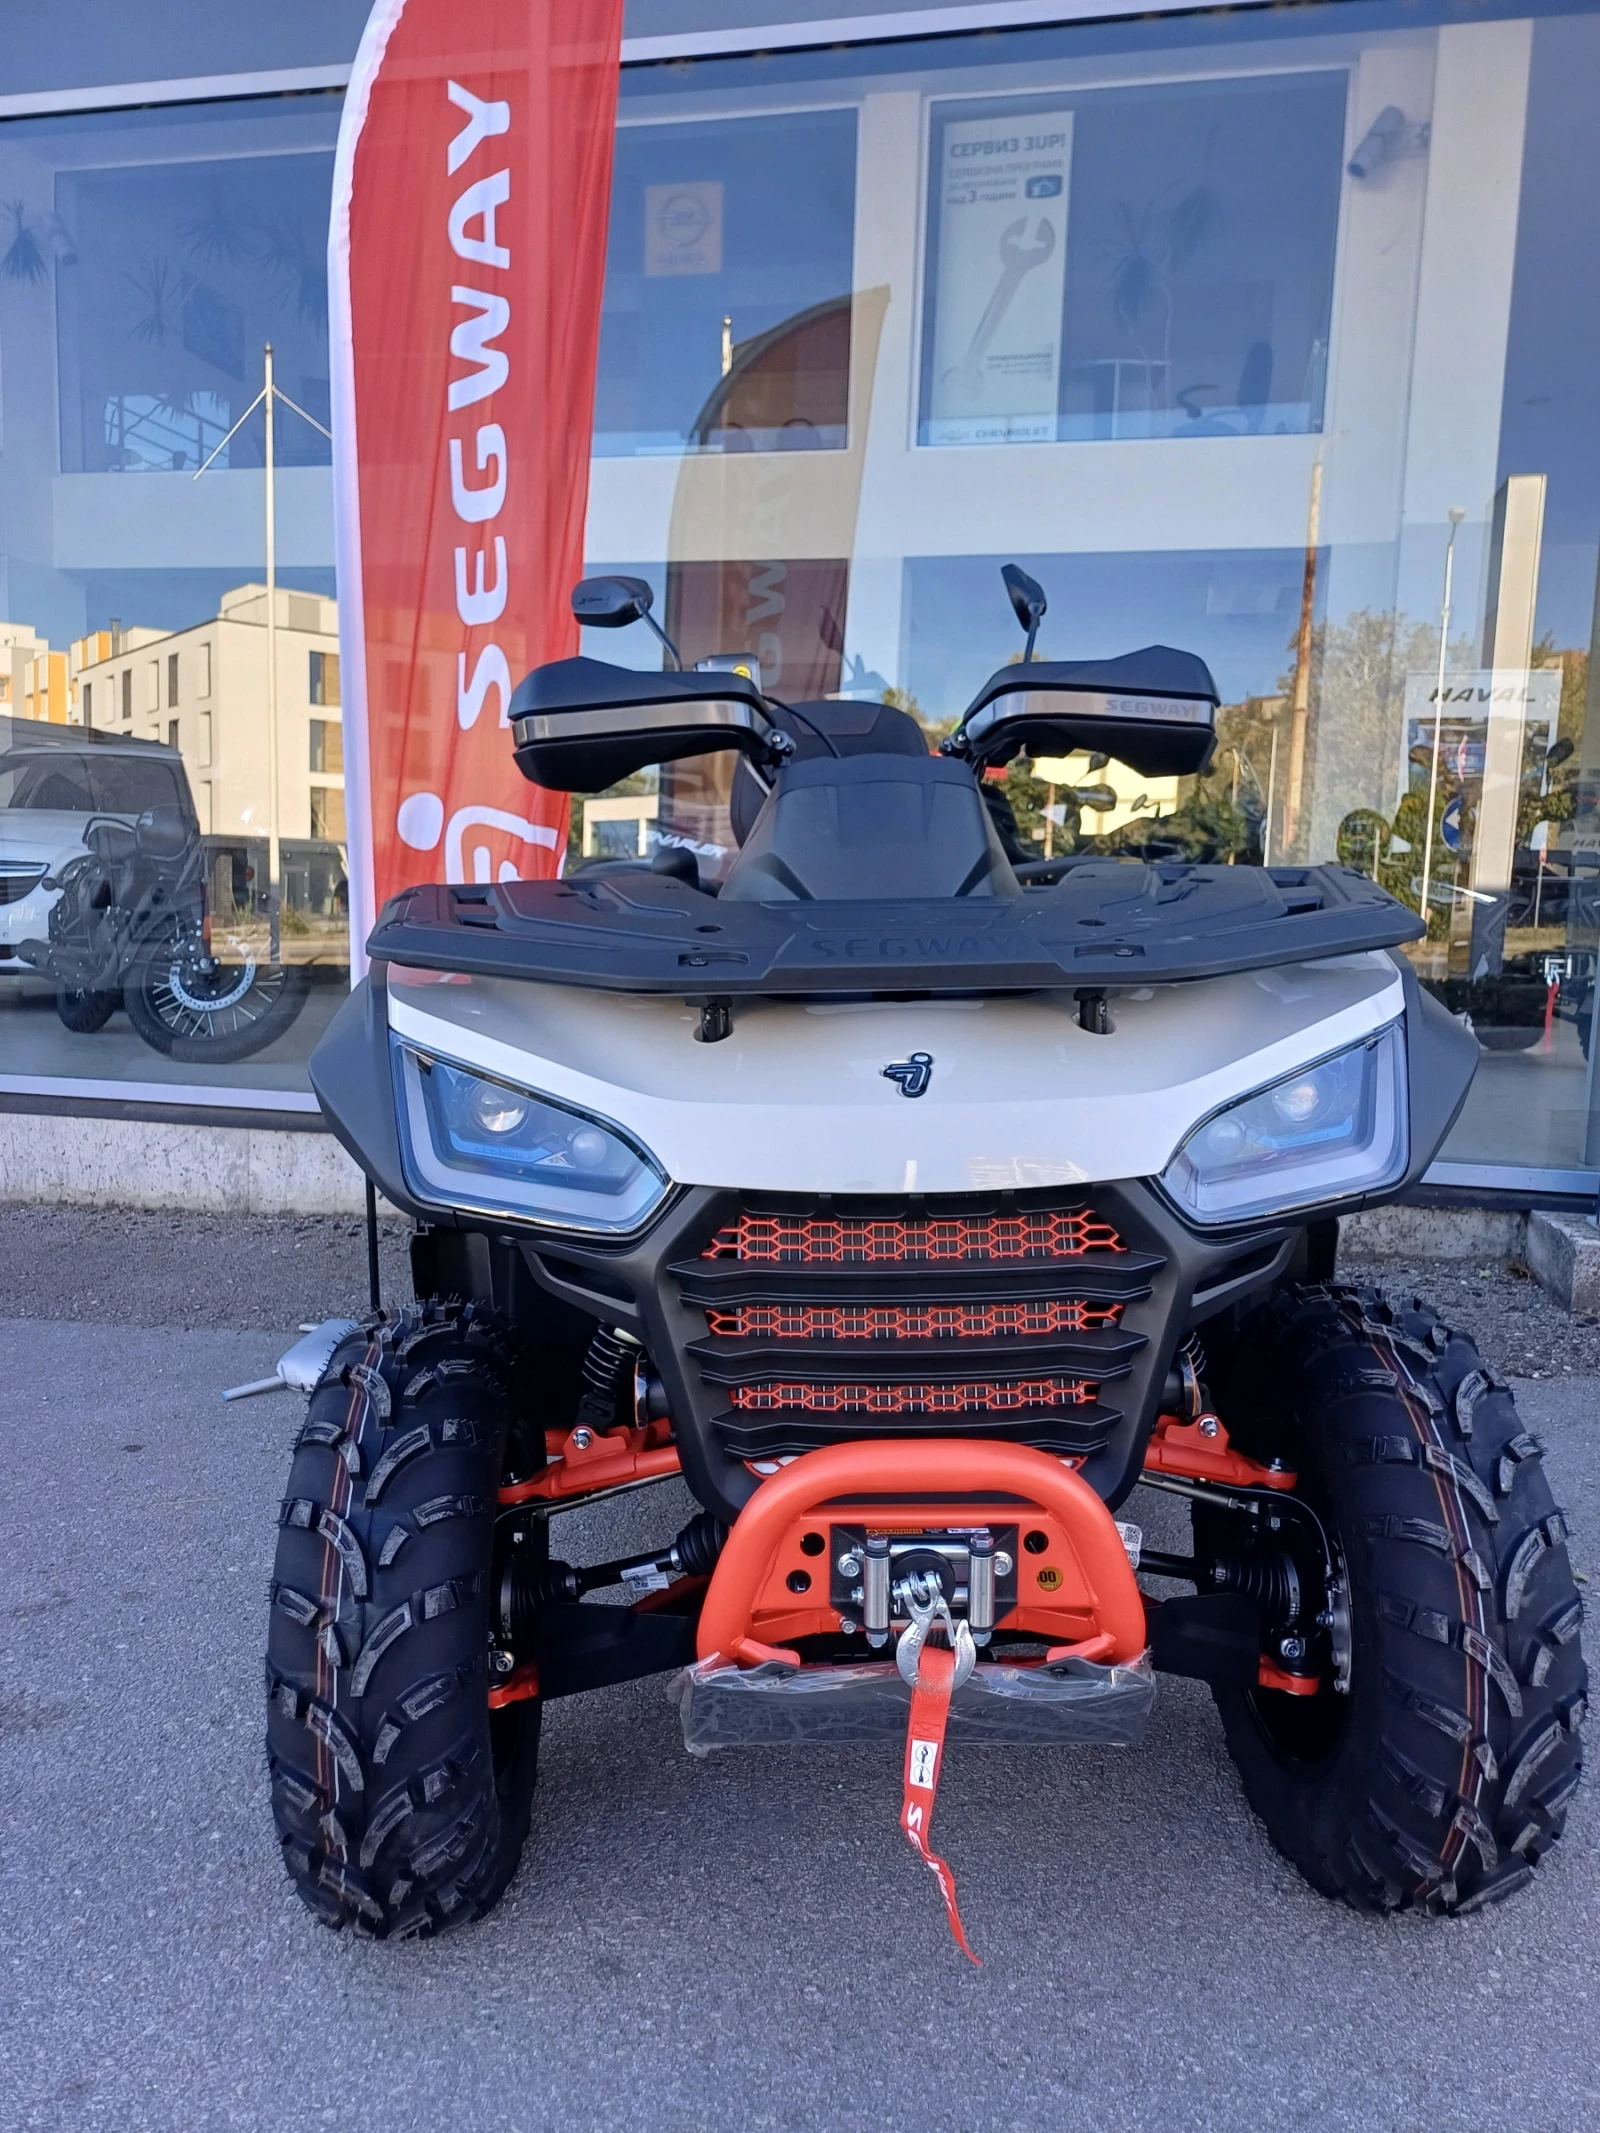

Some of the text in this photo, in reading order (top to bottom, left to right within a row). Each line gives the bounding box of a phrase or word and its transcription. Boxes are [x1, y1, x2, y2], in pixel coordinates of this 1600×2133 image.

[447, 79, 512, 731] SEGWAY
[1429, 687, 1536, 703] HAVAL
[1105, 699, 1195, 718] SEGWAY
[808, 936, 1011, 959] SEGWAY
